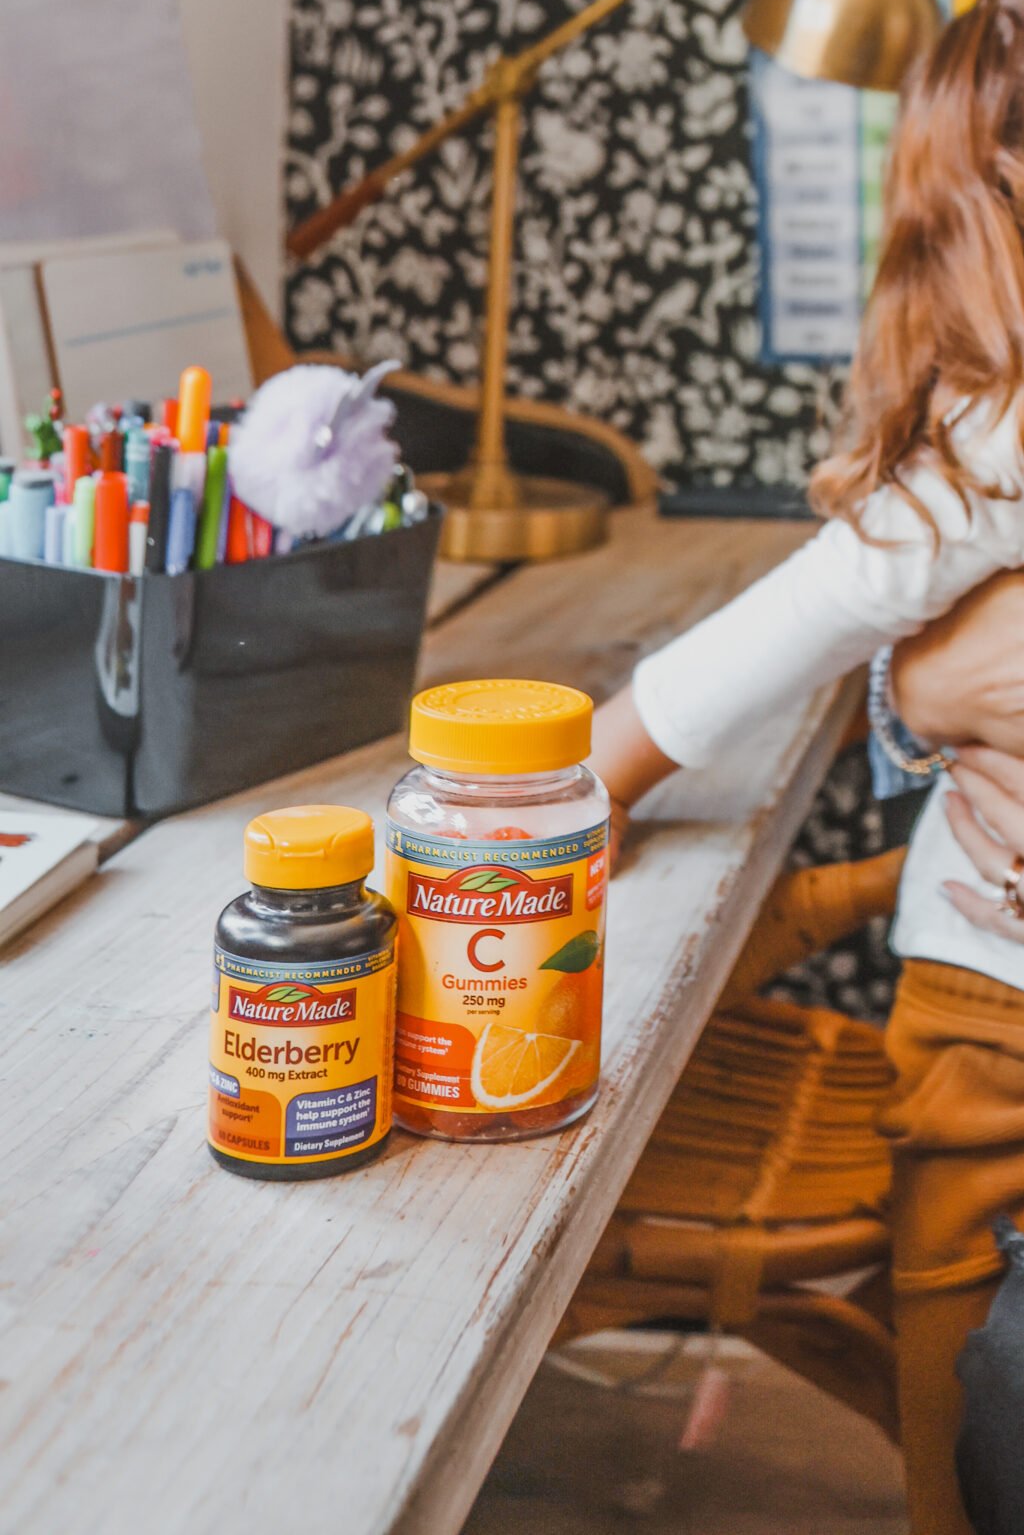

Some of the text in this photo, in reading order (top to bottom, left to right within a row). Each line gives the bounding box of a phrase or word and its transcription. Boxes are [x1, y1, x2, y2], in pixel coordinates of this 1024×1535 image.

[406, 841, 477, 861] PHARMACIST
[484, 844, 579, 861] RECOMMENDED
[413, 884, 495, 917] Nature
[496, 886, 566, 917] Made
[467, 928, 506, 973] C
[227, 963, 280, 979] PHARMACIST
[284, 964, 361, 980] RECOMMENDED
[442, 974, 528, 991] Gummies
[233, 995, 350, 1021] Nature Made
[462, 995, 506, 1007] 250 mg
[224, 1030, 360, 1064] Elderberry
[437, 1037, 452, 1046] the
[245, 1066, 328, 1081] 400 mg Extract
[417, 1068, 460, 1083] Supplement
[220, 1077, 238, 1094] ZINC
[408, 1078, 460, 1099] GUMMIES
[217, 1094, 260, 1113] Antioxidant
[297, 1088, 371, 1109] Vitamin C & Zinc
[296, 1099, 371, 1121] help support the
[297, 1119, 337, 1131] immune
[227, 1132, 270, 1151] CAPSULES
[294, 1130, 365, 1151] Dietary Supplement
